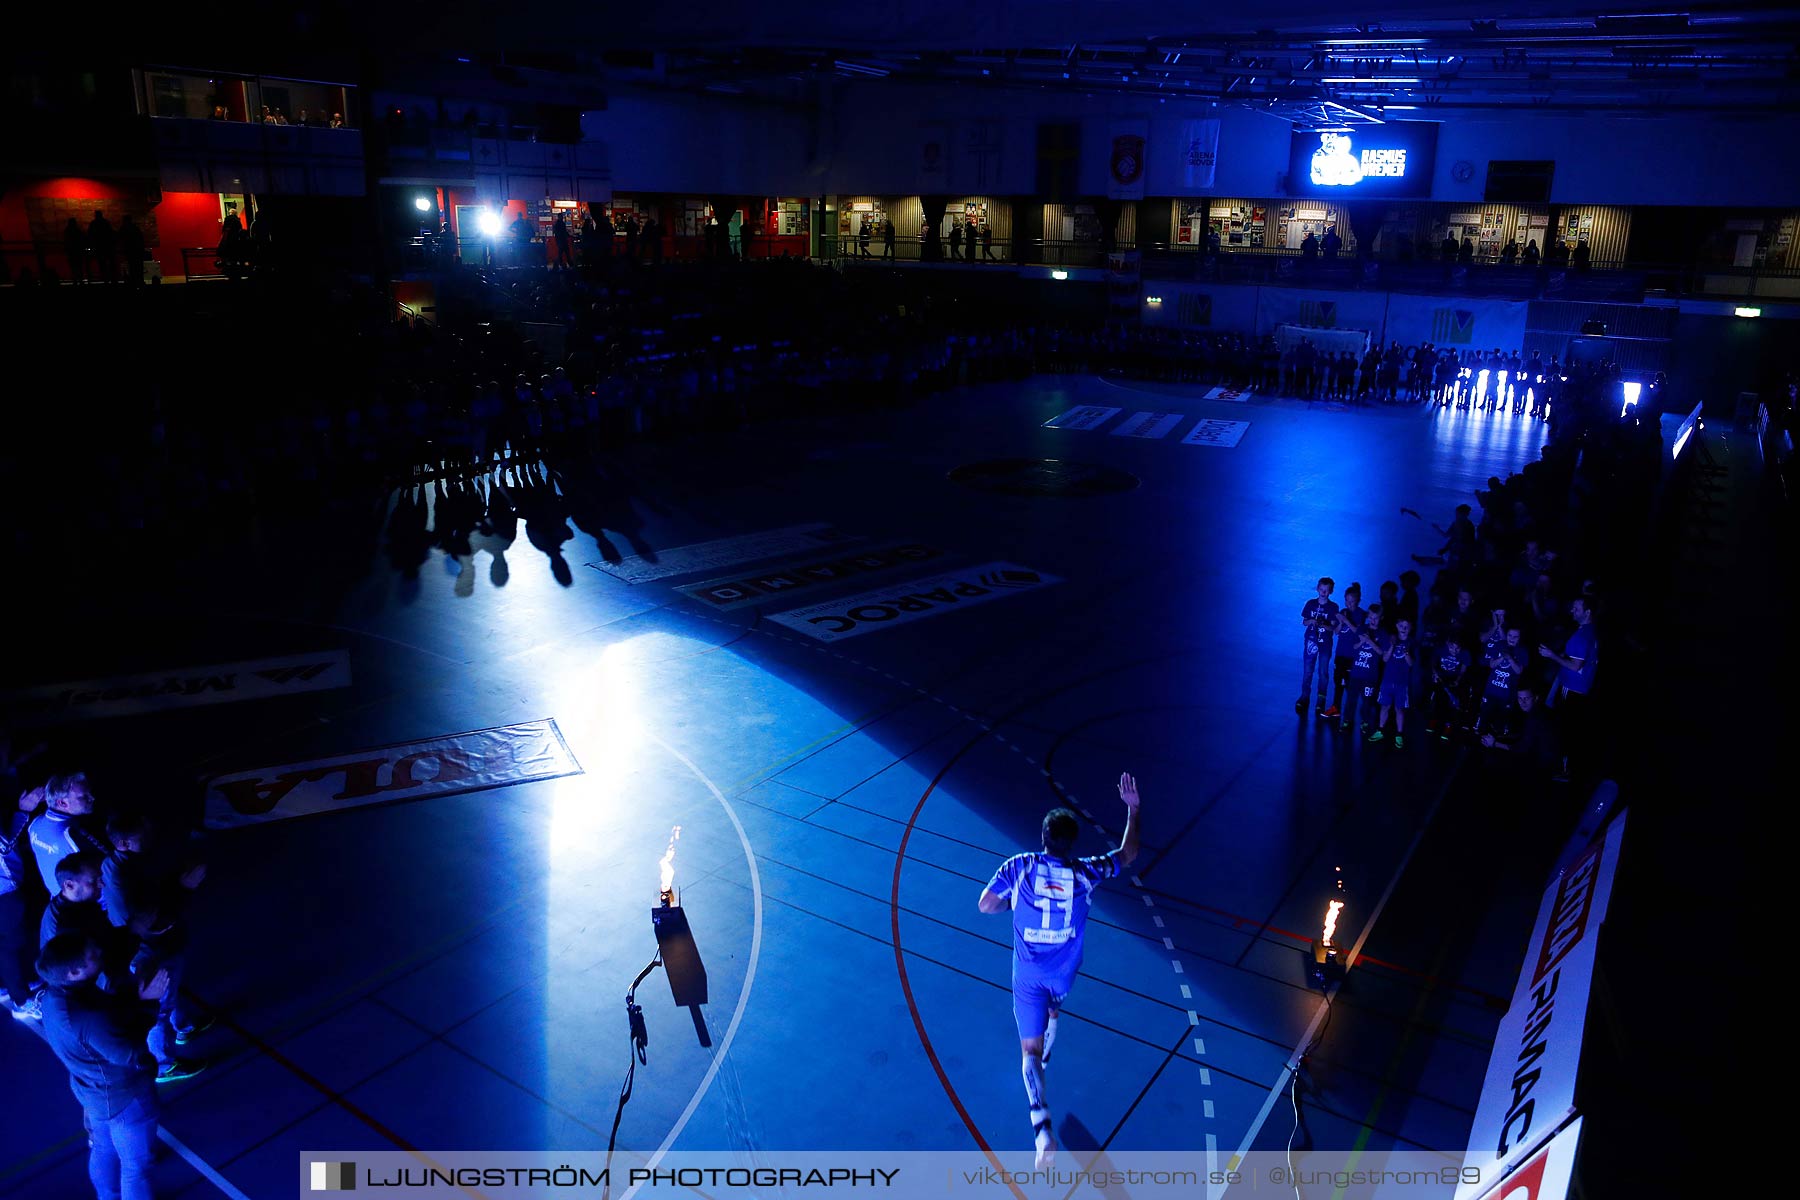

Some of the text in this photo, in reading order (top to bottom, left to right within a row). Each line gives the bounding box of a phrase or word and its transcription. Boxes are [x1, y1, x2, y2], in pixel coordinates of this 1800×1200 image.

[1361, 149, 1407, 162] RASMUS
[810, 582, 989, 634] PAROC
[212, 744, 500, 815] ULA
[1033, 896, 1074, 929] 11
[1543, 852, 1597, 972] EXTRA
